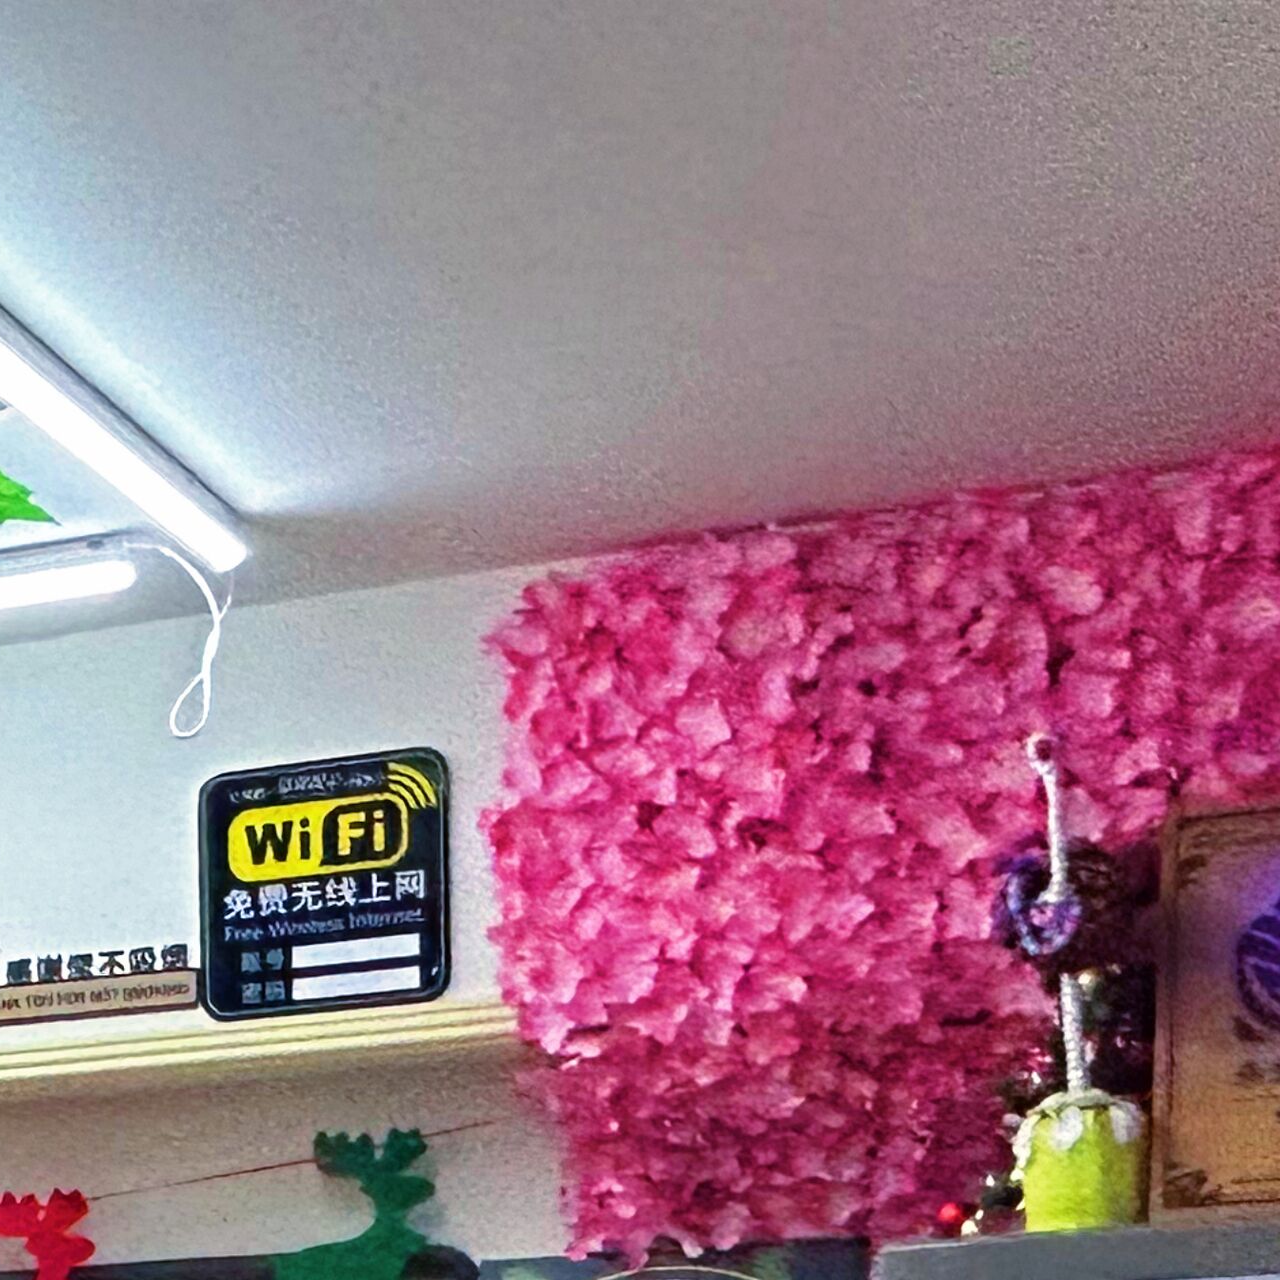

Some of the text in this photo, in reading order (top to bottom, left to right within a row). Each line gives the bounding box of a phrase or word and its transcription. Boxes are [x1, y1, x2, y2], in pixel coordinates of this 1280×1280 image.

[244, 808, 387, 867] WiFi
[223, 869, 426, 920] 免费无线上网
[224, 925, 264, 942] Free
